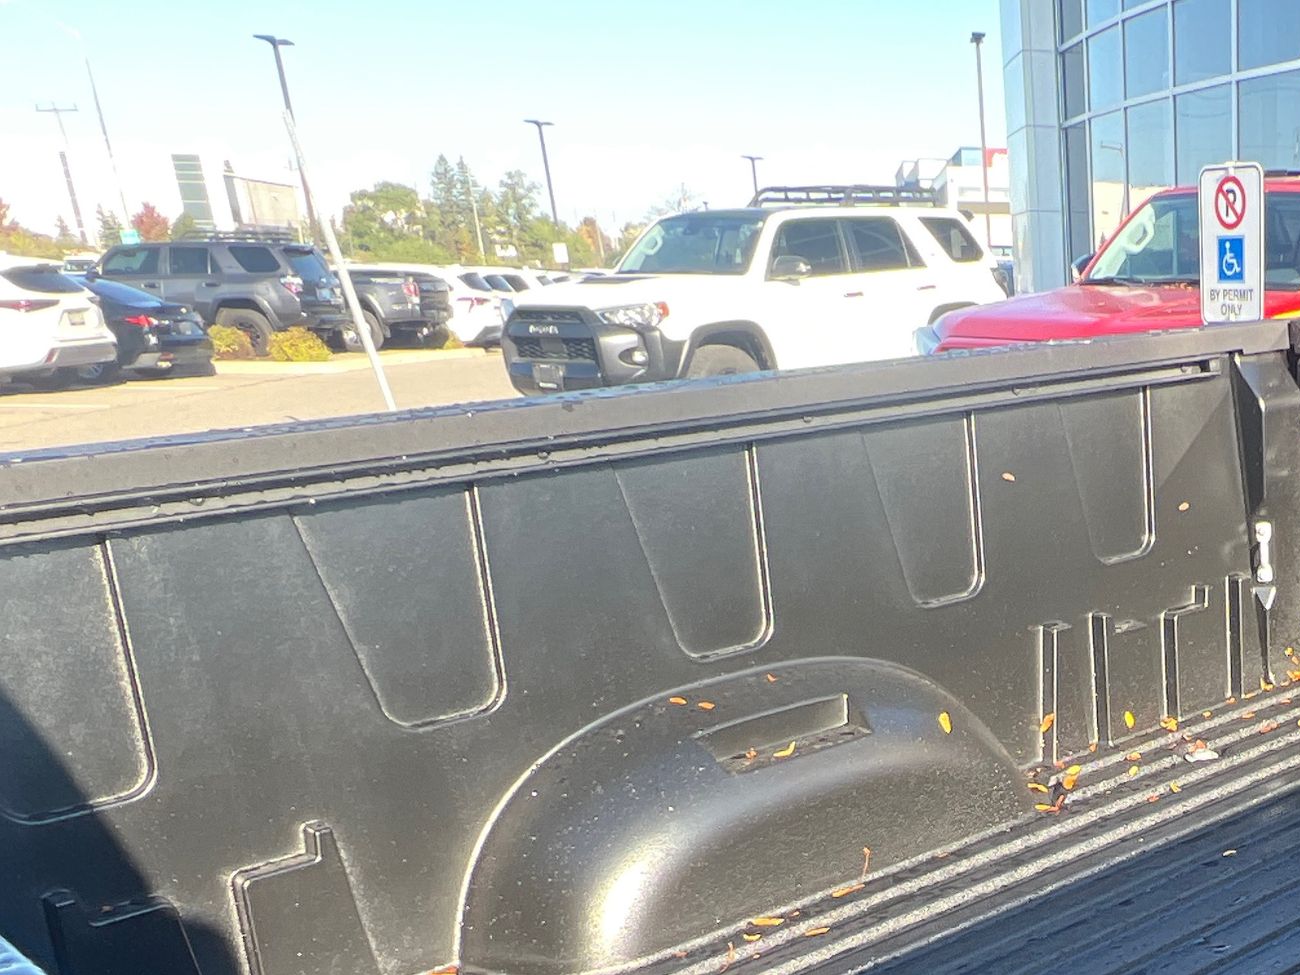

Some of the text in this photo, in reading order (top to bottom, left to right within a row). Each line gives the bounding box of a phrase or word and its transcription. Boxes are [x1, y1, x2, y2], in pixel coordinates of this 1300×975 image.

[1210, 288, 1253, 302] BY PERMIT
[1221, 303, 1242, 316] ONLY
